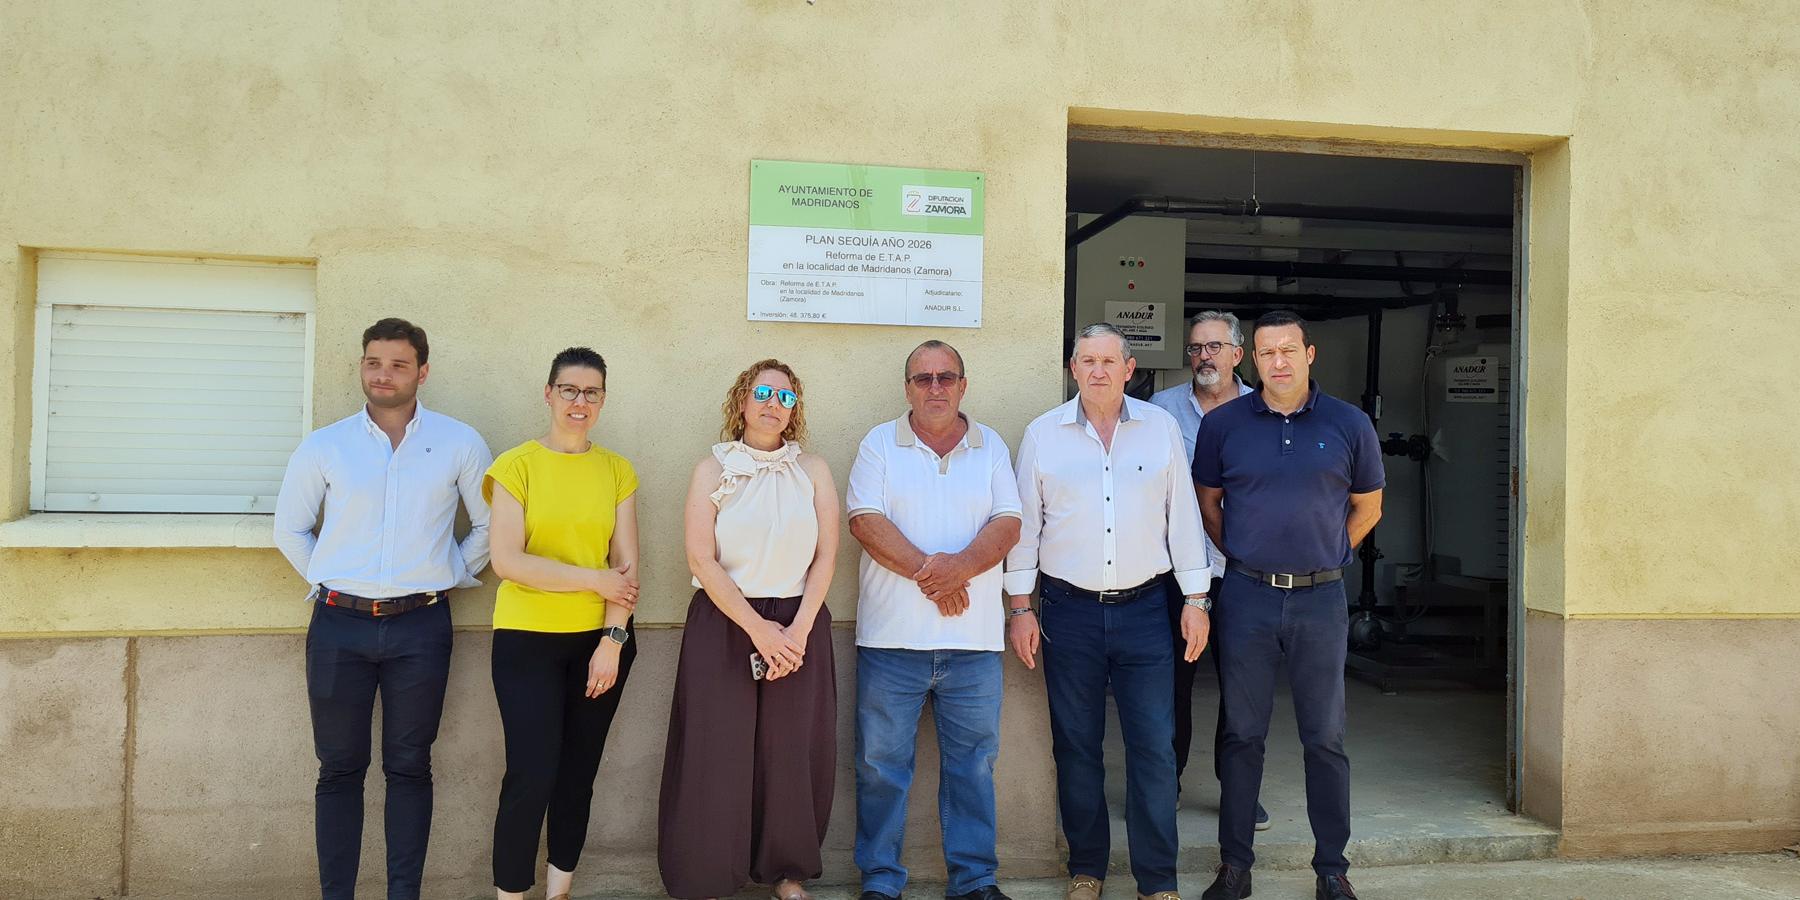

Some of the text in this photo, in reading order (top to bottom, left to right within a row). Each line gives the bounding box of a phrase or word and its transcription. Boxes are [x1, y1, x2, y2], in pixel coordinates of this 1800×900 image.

[778, 185, 873, 198] AYUNTAMIENTO DE
[791, 198, 860, 209] MADRIDANOS
[924, 204, 966, 214] ZAMORA
[805, 235, 932, 249] PLAN SEQUÍA AÑO 2026
[825, 251, 912, 262] Reforma de E.T.A.P.
[796, 261, 805, 270] la
[806, 262, 846, 272] localidad
[847, 263, 859, 272] de
[861, 264, 911, 274] Madridanos
[913, 266, 953, 277] (Zamora)
[1116, 311, 1154, 319] ANADUR
